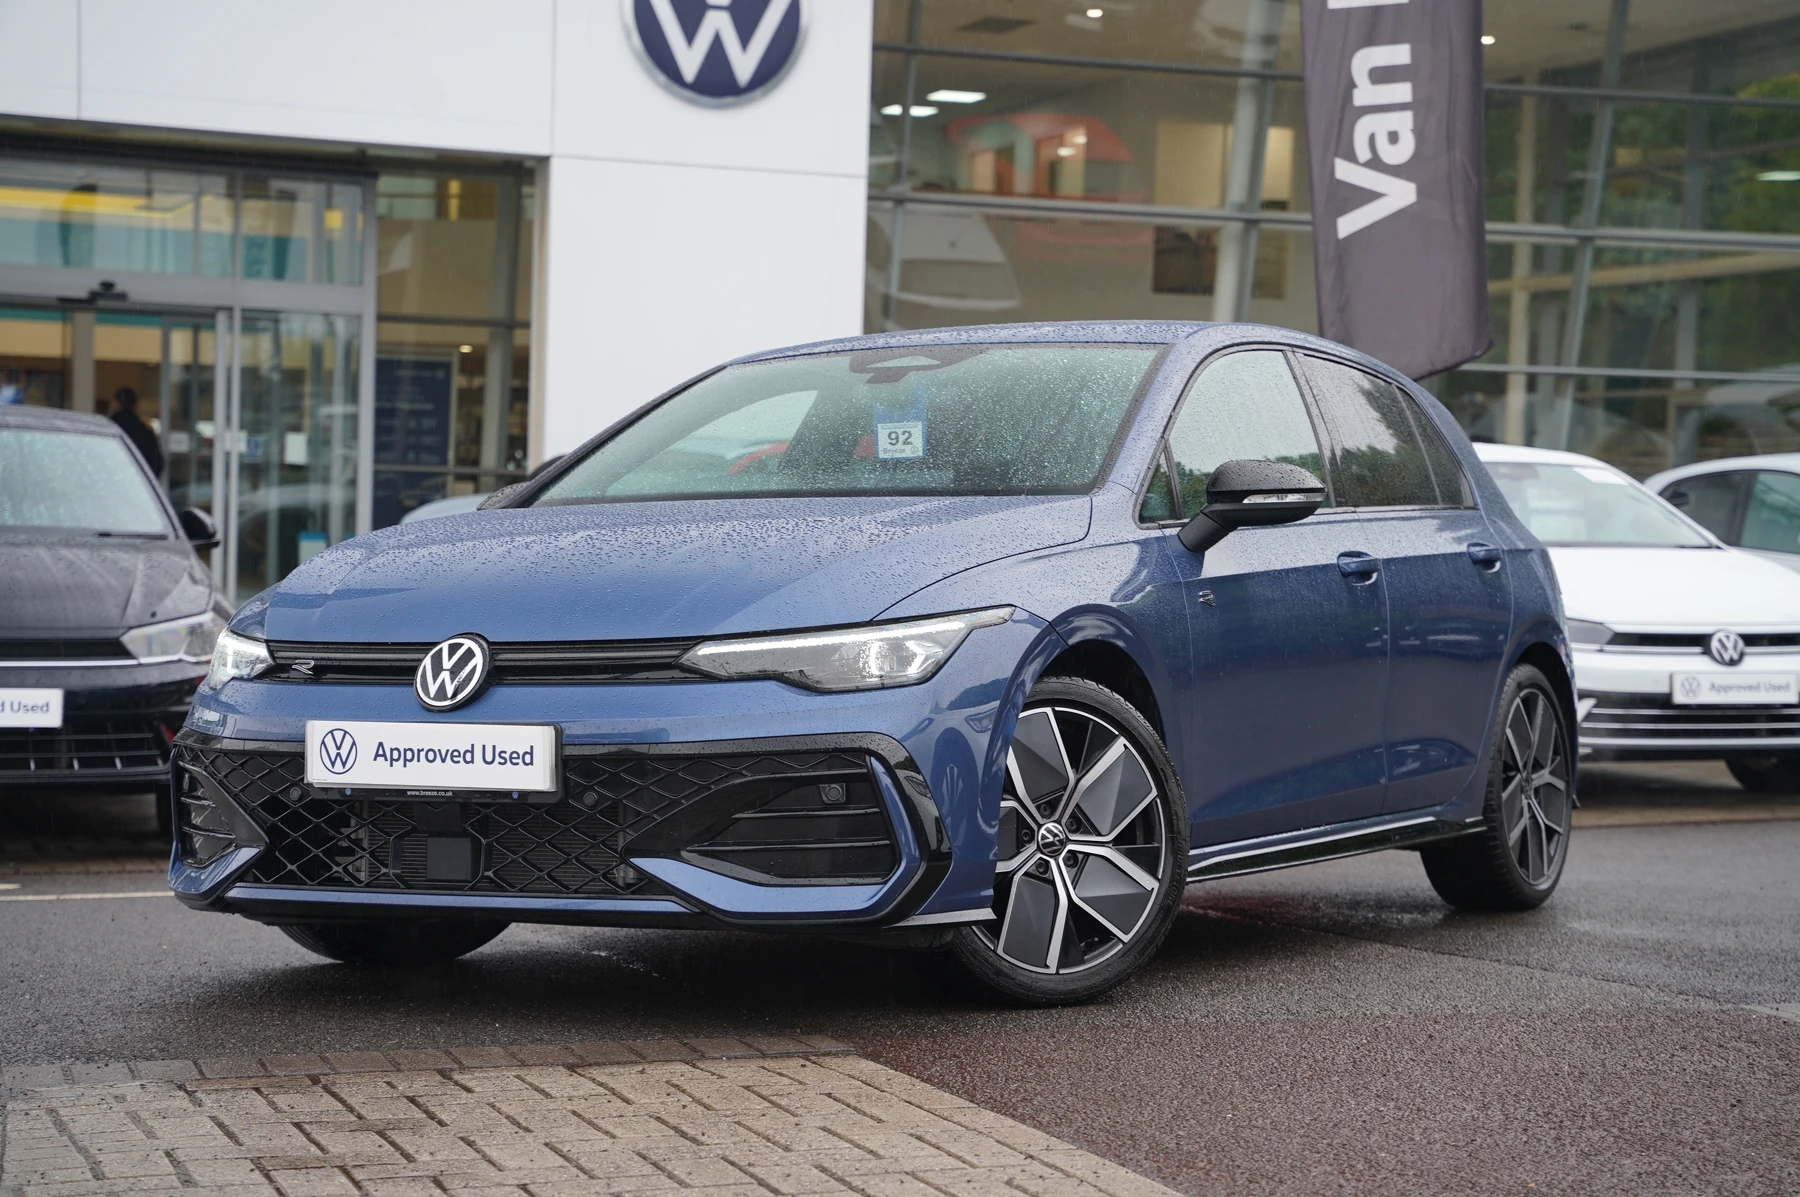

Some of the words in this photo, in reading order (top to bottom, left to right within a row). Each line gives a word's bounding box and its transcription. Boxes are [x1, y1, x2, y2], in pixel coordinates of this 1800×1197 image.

[1334, 43, 1417, 240] Van
[887, 430, 914, 447] 92
[10, 700, 50, 714] Used
[373, 741, 475, 768] Approved
[481, 744, 534, 767] Used
